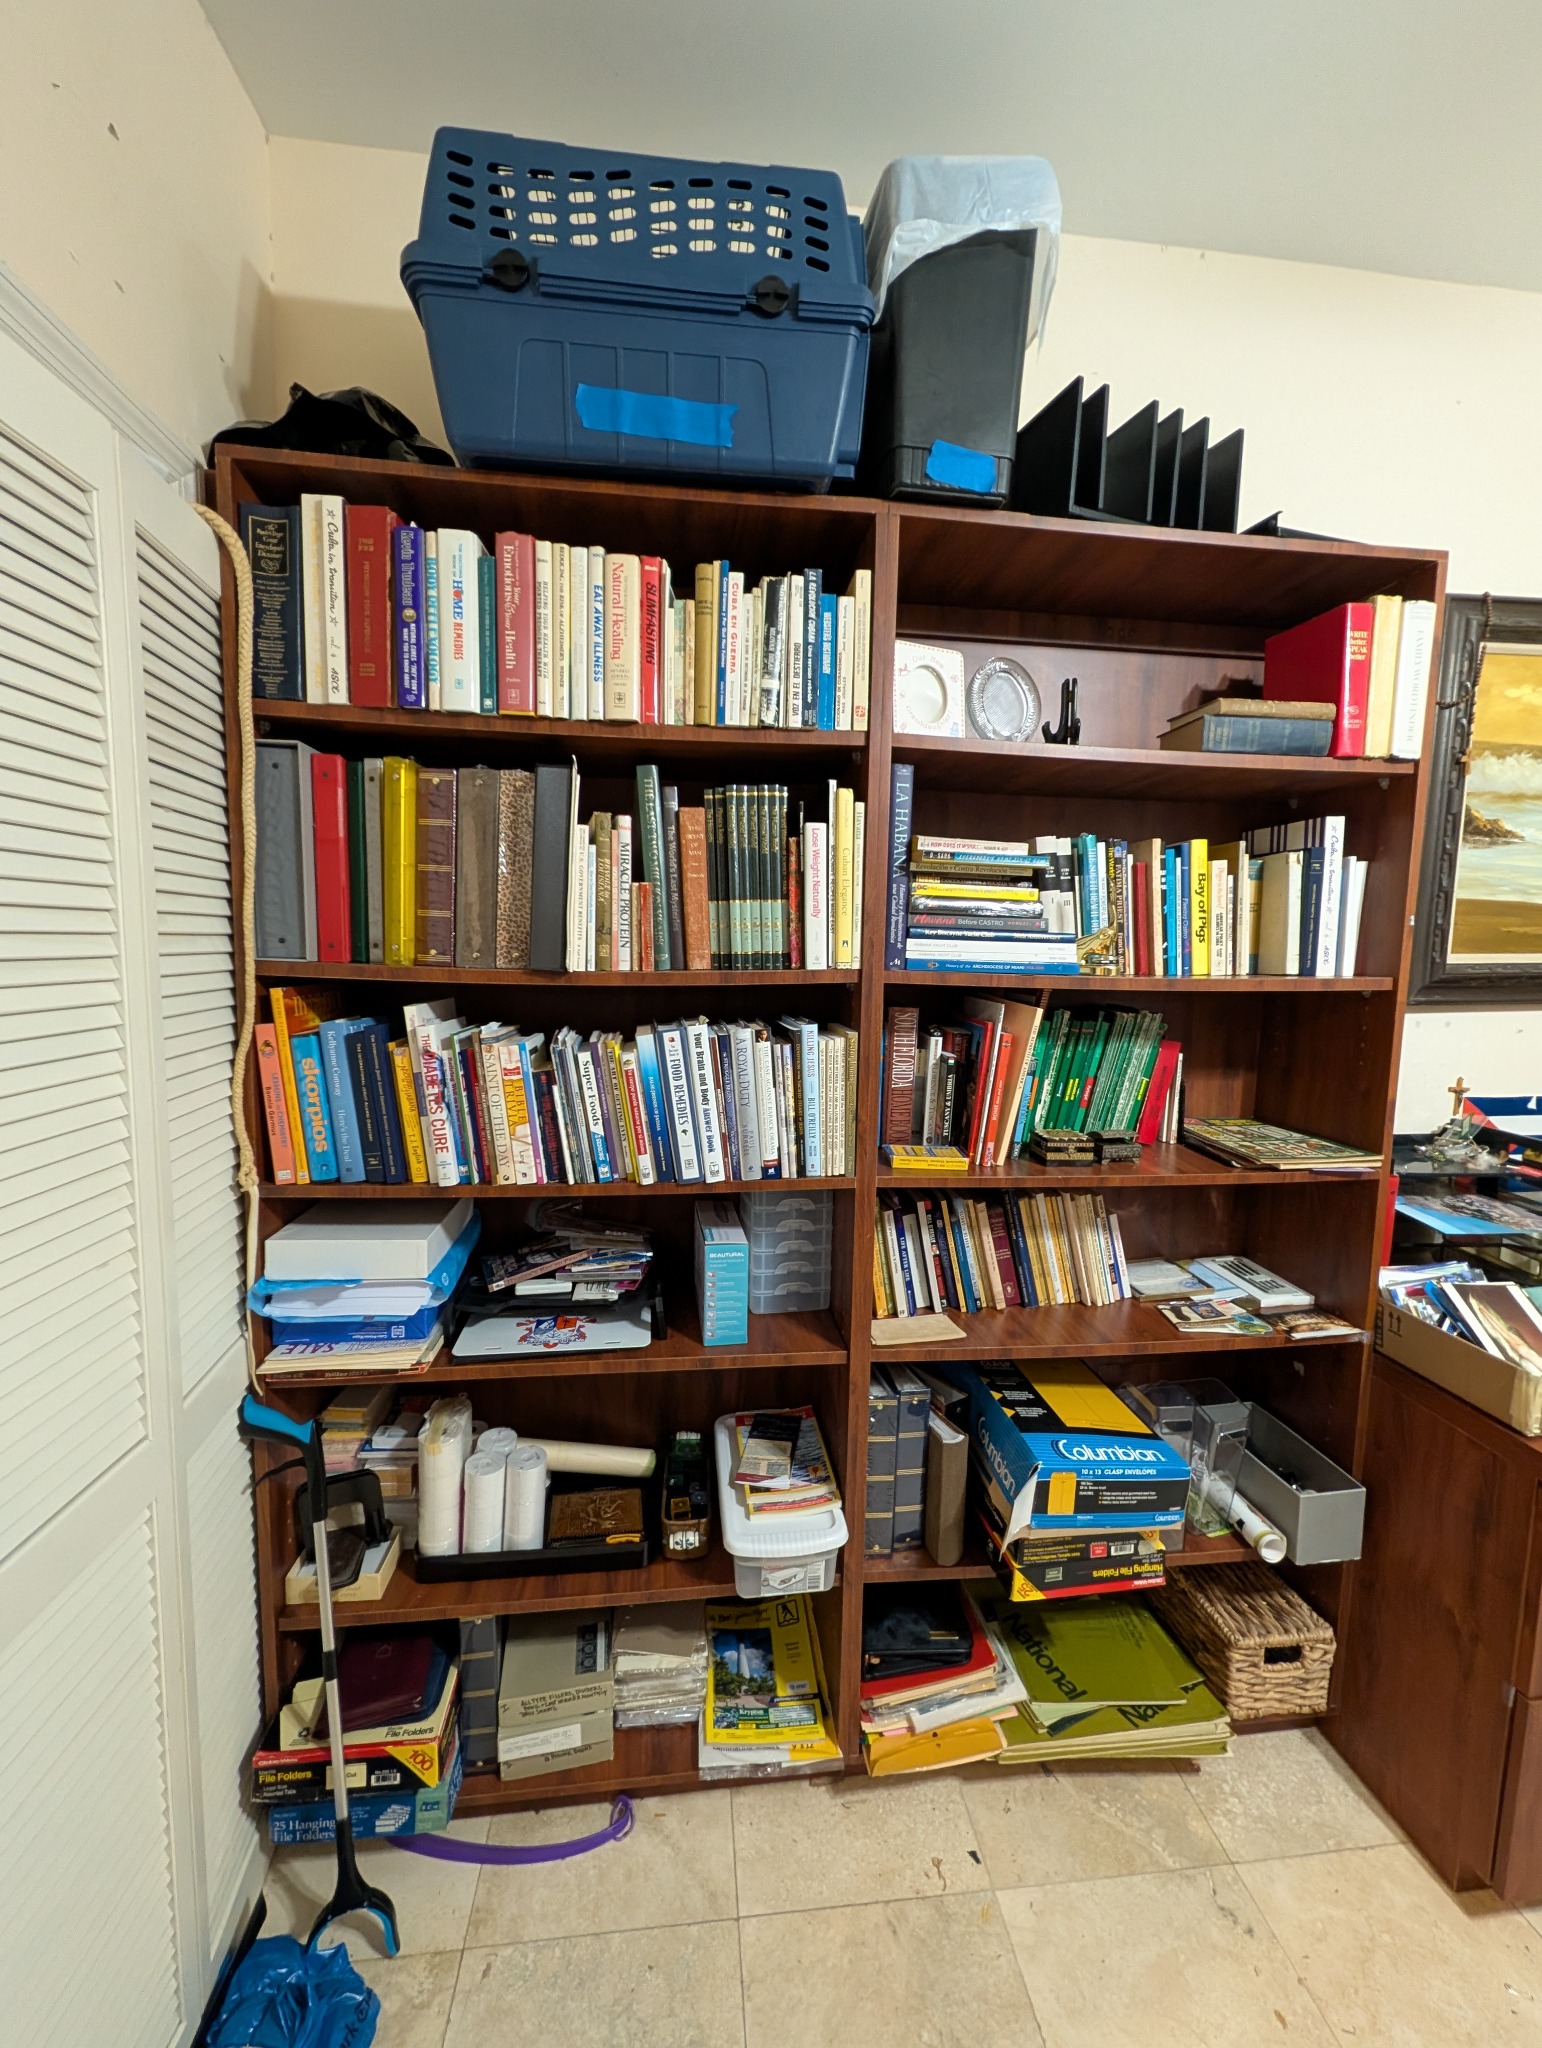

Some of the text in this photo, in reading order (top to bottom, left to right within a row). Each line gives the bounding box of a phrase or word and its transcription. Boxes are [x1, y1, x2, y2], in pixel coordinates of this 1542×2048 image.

[327, 522, 339, 614] Cuba in transition
[401, 530, 415, 606] Kevin Trudeau
[612, 562, 624, 609] Natural
[594, 585, 602, 682] EAT AWAY ILLNESS
[610, 612, 624, 660] Healing
[645, 582, 657, 665] SLIMFASTING
[731, 615, 737, 628] EN
[453, 622, 464, 660] REMEDIES
[330, 667, 340, 694] ASCE
[1406, 630, 1424, 742] FAMILY WORD FINDER
[893, 782, 909, 878] LA HABANA
[597, 857, 605, 903] LOUISIANA
[667, 825, 675, 842] The
[671, 892, 680, 932] Mysteries
[810, 828, 820, 919] Lose Weight Naturally
[840, 848, 851, 916] Cuban Elegance
[1327, 835, 1339, 905] Cuba in transition
[620, 841, 631, 949] MIRACLE PROTEIN
[1195, 873, 1207, 943] Bay of Pigs
[693, 1032, 702, 1049] Your
[806, 1030, 814, 1055] KILLING
[894, 1012, 916, 1044] SOUTH
[696, 1051, 704, 1072] Brain
[737, 1048, 749, 1079] ROYAL
[891, 1046, 915, 1089] FLORIDA
[421, 1034, 449, 1155] THE DIABETES CURE
[582, 1060, 600, 1126] Super Foods
[613, 1083, 619, 1092] OF
[669, 1059, 689, 1125] FOOD REMEDIES
[739, 1081, 751, 1108] DUTY
[929, 1063, 940, 1097] FLORENCE
[265, 1086, 277, 1136] Bonnie Garmus
[301, 1057, 329, 1153] skorpios
[327, 1030, 351, 1162] Kellyanne Conway Here's the Deal
[484, 1054, 510, 1168] SAINT OF THE DAY
[504, 1081, 517, 1128] TRIVIA
[515, 1086, 527, 1122] BIBLE
[614, 1093, 622, 1124] GETTING
[700, 1088, 709, 1106] Body
[891, 1089, 912, 1118] HOME
[1019, 1094, 1030, 1125] AUSTRIA
[703, 1108, 712, 1133] Answer
[808, 1112, 817, 1139] O'REILLY
[927, 1106, 935, 1137] TUSCANY
[942, 1106, 950, 1137] TUSCANY
[706, 1135, 715, 1154] Book
[768, 1133, 776, 1155] OBAMA
[1013, 1143, 1021, 1158] 2006
[1101, 1216, 1109, 1235] STREET
[1104, 1237, 1112, 1261] SWEEPER
[280, 1343, 339, 1355] SALE
[977, 1416, 1016, 1496] Columbian
[1051, 1439, 1166, 1462] Columbian
[1153, 1513, 1181, 1522] Columbian
[1092, 1569, 1118, 1578] Folders
[1133, 1564, 1164, 1576] Hanging
[1018, 1581, 1035, 1598] 25
[1000, 1611, 1089, 1702] National
[384, 1726, 434, 1738] File Folders
[409, 1749, 434, 1771] 100
[259, 1771, 312, 1784] File Folders
[272, 1829, 336, 1842] File Folders
[273, 1818, 336, 1832] 25 Hanging
